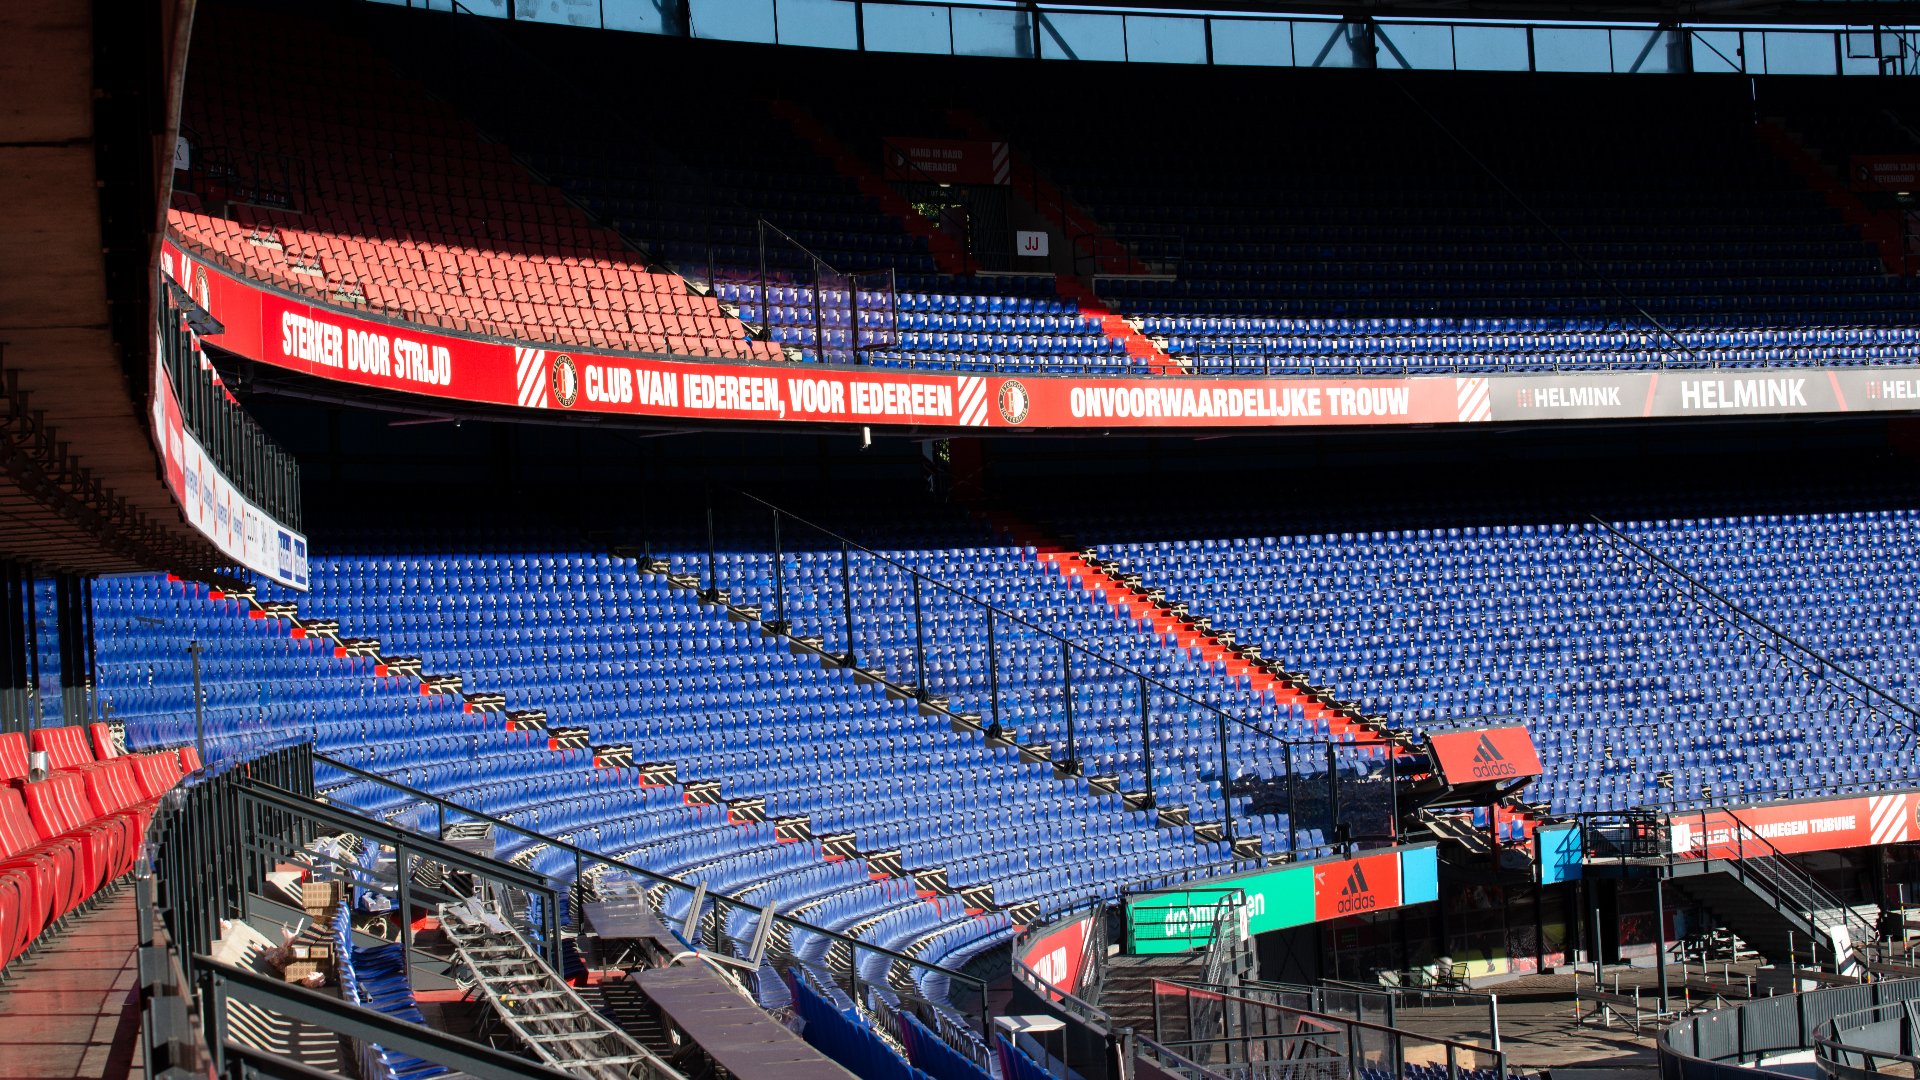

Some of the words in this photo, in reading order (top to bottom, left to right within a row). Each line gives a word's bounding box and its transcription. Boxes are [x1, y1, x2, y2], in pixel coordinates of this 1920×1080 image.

[910, 147, 931, 158] HAND
[932, 148, 941, 159] IN
[942, 149, 963, 160] HAND
[911, 161, 957, 173] KAMERADEN
[1873, 163, 1898, 172] SAMEN
[1900, 163, 1915, 172] ZIJN
[1874, 174, 1915, 183] FEYENOORD
[1025, 236, 1039, 251] JJ
[282, 310, 344, 369] STERKER
[348, 329, 391, 377] DOOR
[394, 337, 451, 386] STRIJD
[585, 364, 633, 404] CLUB
[636, 369, 678, 407] VAN
[683, 373, 785, 419] IEDEREEN,
[788, 379, 846, 414] VOOR
[850, 381, 953, 417] IEDEREEN
[1534, 386, 1621, 408] HELMINK
[1681, 378, 1807, 409] HELMINK
[1070, 387, 1322, 418] ONVOORWAARDELIJKE
[1326, 387, 1410, 417] TROUW
[1473, 760, 1516, 778] adidas
[1755, 820, 1808, 839] HANEGEM
[1810, 815, 1856, 833] TRIBUNE
[1338, 893, 1376, 914] adidas
